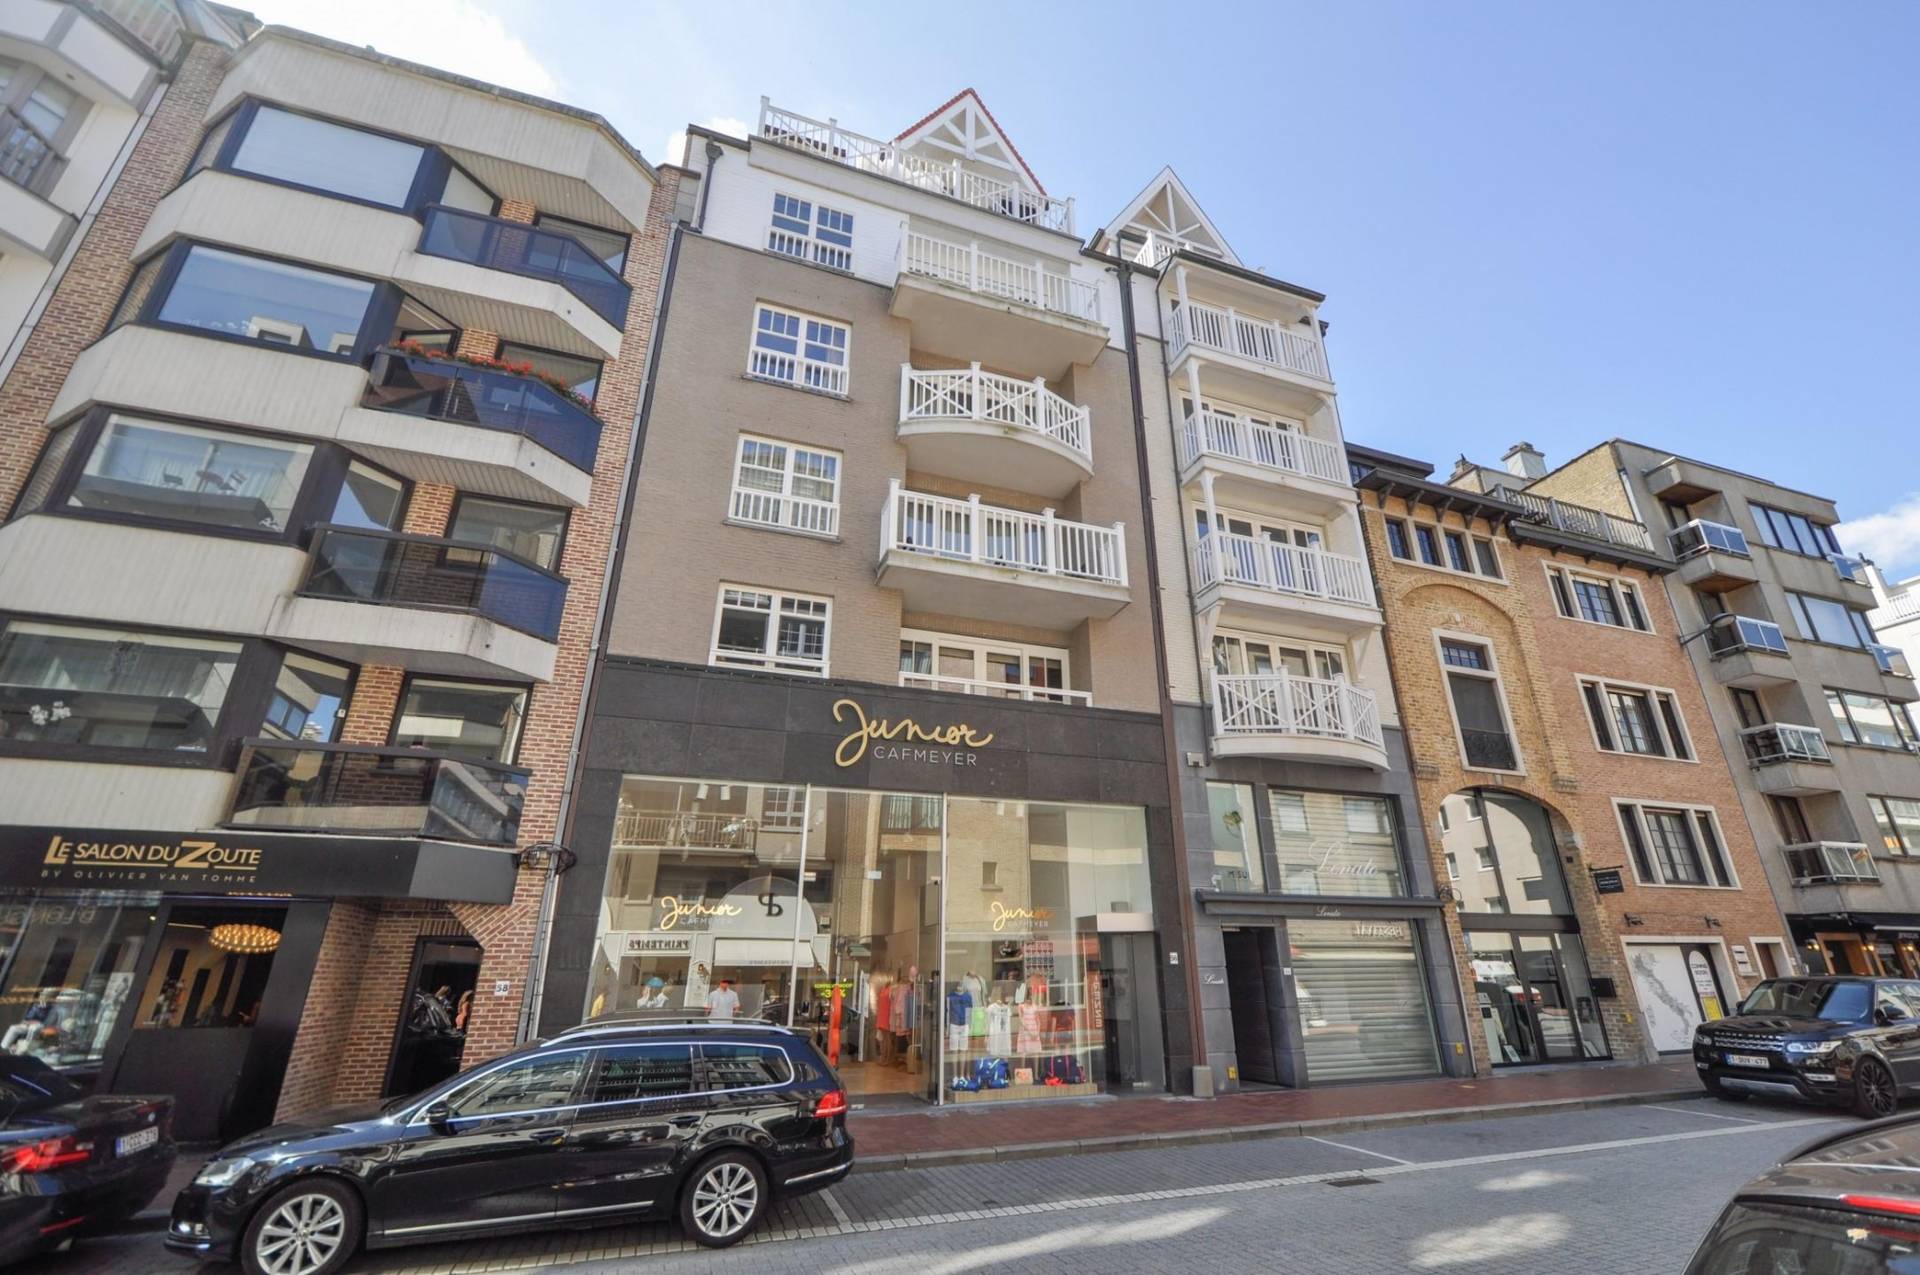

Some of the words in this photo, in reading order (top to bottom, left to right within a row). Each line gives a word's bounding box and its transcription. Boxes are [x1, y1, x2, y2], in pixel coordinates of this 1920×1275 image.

[833, 699, 994, 767] Junior
[873, 746, 977, 766] CAFMEYER
[73, 842, 145, 861] SALON
[147, 844, 181, 861] DU
[174, 840, 263, 868] ZOUTE
[41, 870, 62, 879] BY
[74, 870, 148, 880] OLIVIER
[159, 872, 190, 881] VAN
[201, 873, 257, 883] TOMME
[661, 896, 742, 930] Junior
